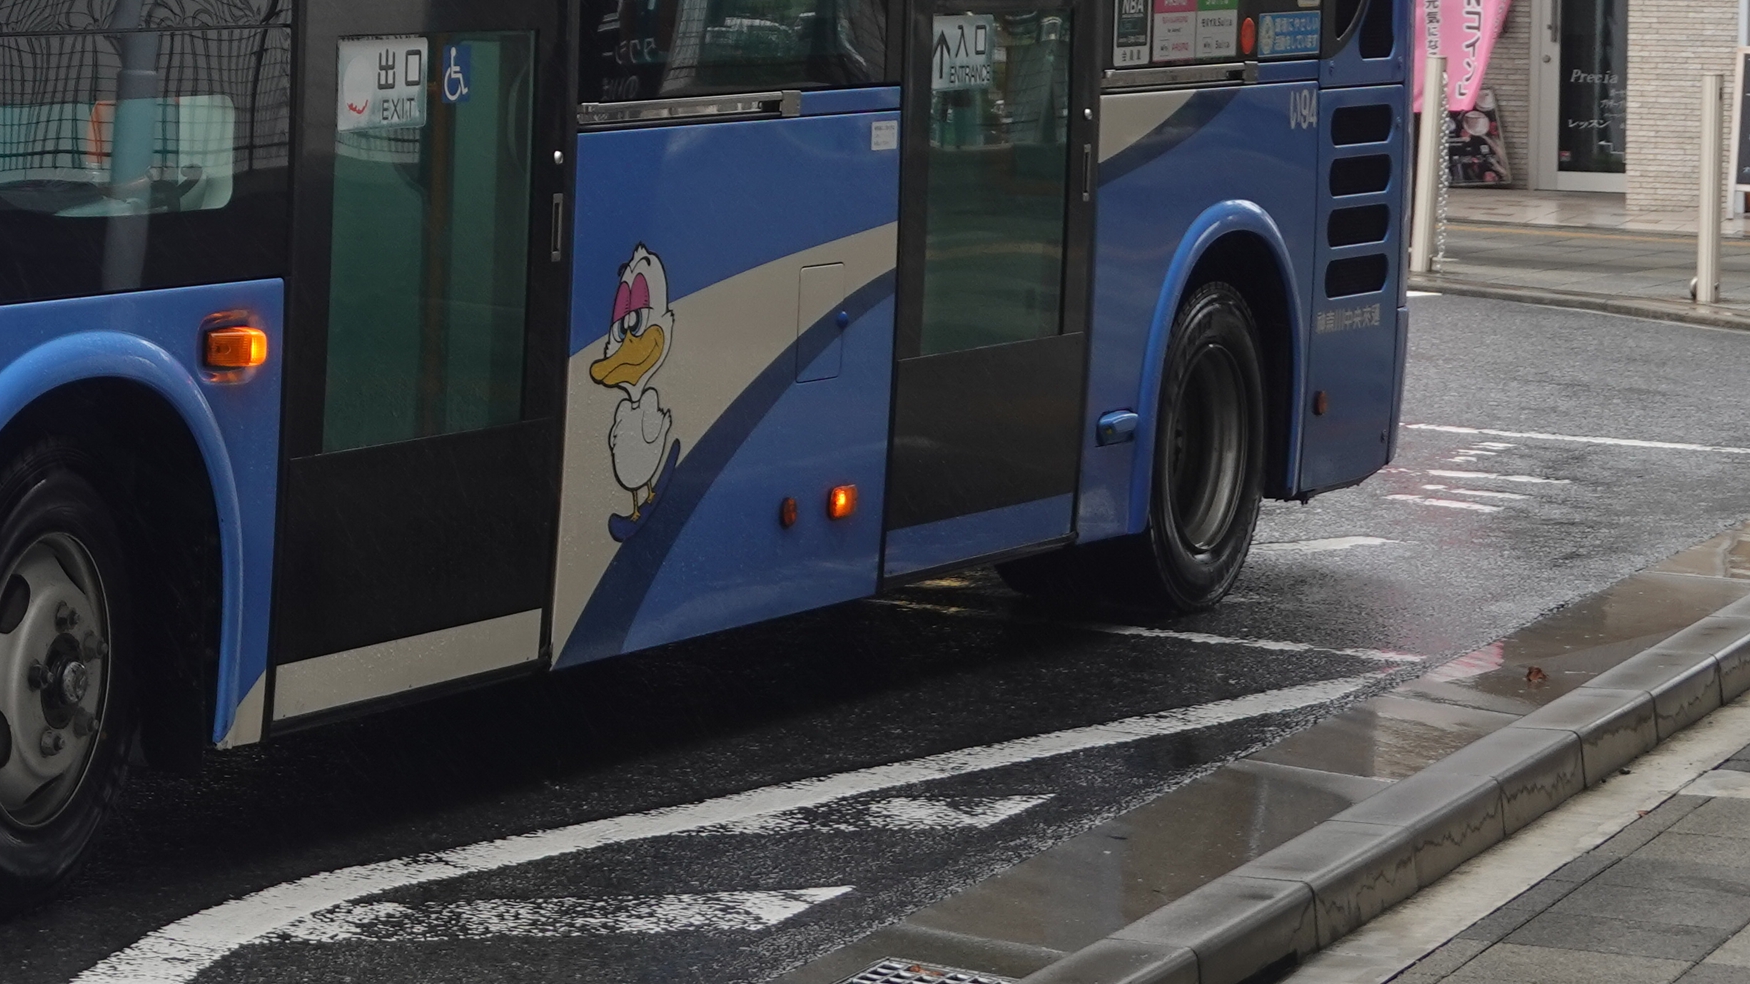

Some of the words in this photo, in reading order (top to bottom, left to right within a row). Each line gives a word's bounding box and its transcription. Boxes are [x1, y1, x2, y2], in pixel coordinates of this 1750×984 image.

[955, 25, 987, 58] 入口
[377, 48, 422, 91] 出口
[950, 64, 991, 84] ENTRANCE
[1570, 69, 1619, 84] Precia
[382, 97, 415, 121] EXIT
[1289, 88, 1318, 130] い94
[1568, 118, 1612, 130] レッスン
